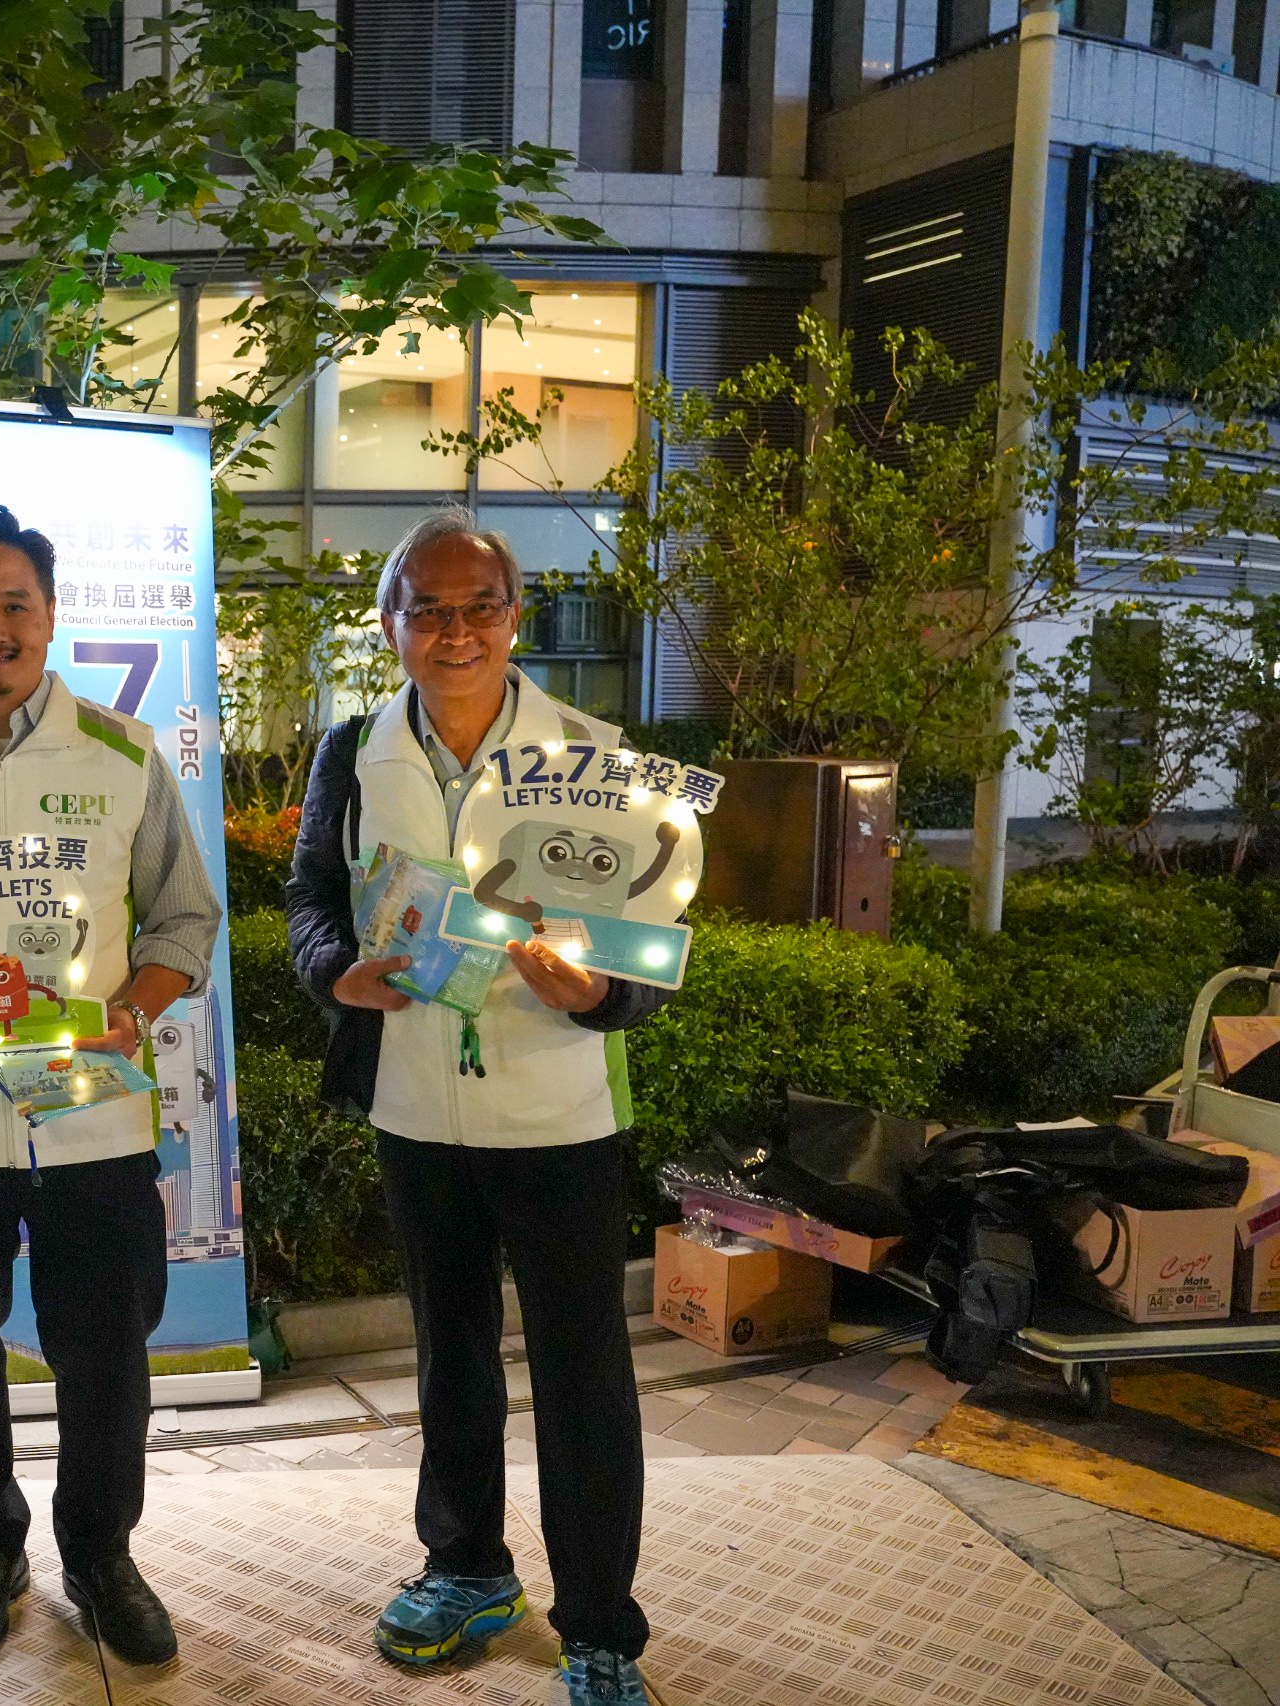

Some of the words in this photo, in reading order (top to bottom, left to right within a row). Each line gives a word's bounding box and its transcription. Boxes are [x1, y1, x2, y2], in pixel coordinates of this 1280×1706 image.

[124, 557, 145, 570] the
[149, 559, 192, 572] Future
[57, 581, 192, 610] 會換屆選舉
[61, 613, 101, 625] Council
[104, 615, 147, 626] General
[150, 616, 194, 627] Election
[178, 707, 198, 722] 7
[180, 729, 200, 779] DEC
[490, 745, 596, 787] 12.7
[600, 751, 720, 810] 齊投票
[39, 793, 116, 816] CEPU
[502, 786, 563, 808] LET'S
[569, 787, 629, 813] VOTE
[16, 900, 73, 920] VOTE
[1160, 1254, 1214, 1279] Copy
[667, 1276, 709, 1300] Copy
[1183, 1276, 1210, 1286] Mate
[685, 1300, 707, 1314] Mate
[1149, 1295, 1163, 1307] A4
